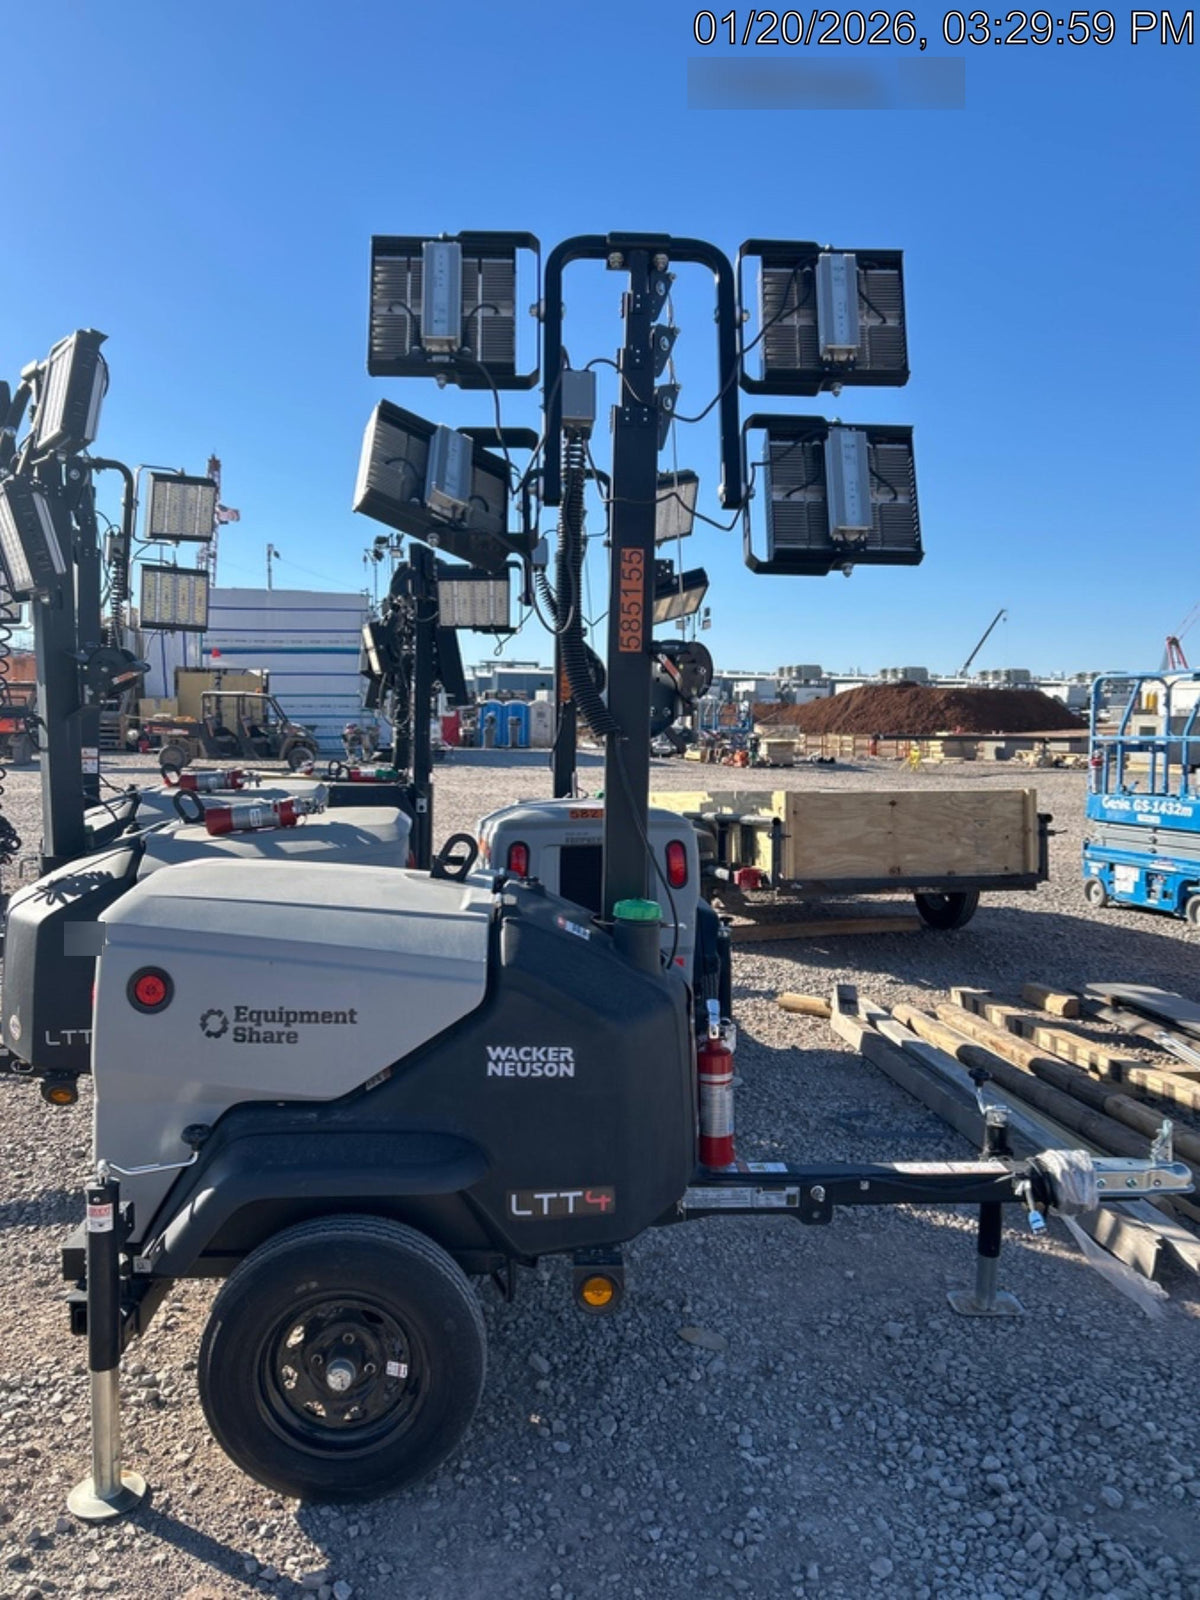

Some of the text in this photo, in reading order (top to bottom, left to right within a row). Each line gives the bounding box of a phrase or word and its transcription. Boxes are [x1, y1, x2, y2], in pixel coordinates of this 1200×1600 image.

[620, 550, 643, 650] 585155
[1102, 795, 1131, 811] Genie
[569, 808, 603, 820] 582
[233, 1005, 358, 1027] Equipment
[45, 1028, 93, 1046] LTT
[232, 1026, 299, 1044] Share
[486, 1046, 575, 1061] WACKER
[487, 1061, 575, 1077] NEUSON
[511, 1190, 612, 1216] LTT4
